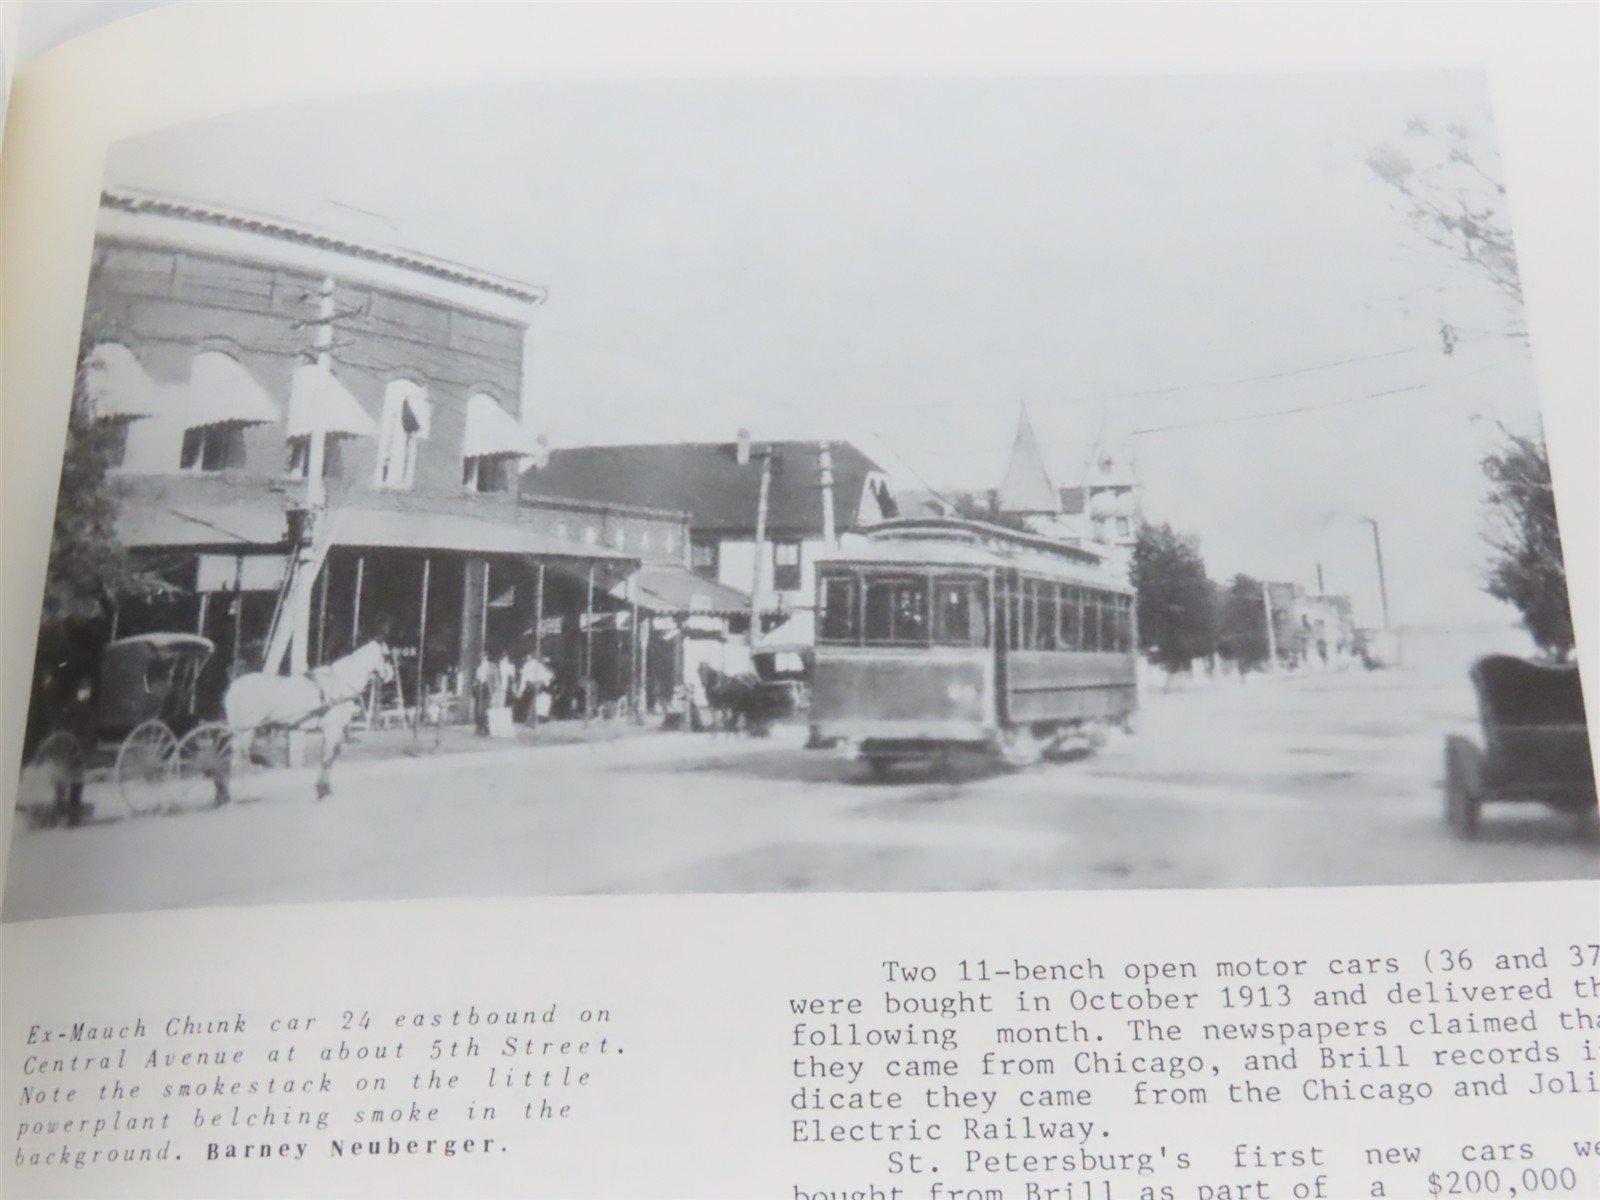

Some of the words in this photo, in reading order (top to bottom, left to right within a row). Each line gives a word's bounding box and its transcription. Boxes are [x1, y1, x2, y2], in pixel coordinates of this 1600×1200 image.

[882, 961, 936, 982] Two
[959, 958, 1104, 981] 11-bench
[1125, 960, 1197, 985] open
[1216, 958, 1307, 977] motor
[1329, 958, 1399, 975] cars
[1425, 949, 1472, 973] (36
[1496, 947, 1548, 970] and
[789, 999, 862, 1014] were
[885, 991, 992, 1018] bought
[1017, 991, 1051, 1011] in
[1070, 988, 1198, 1011] October
[1221, 984, 1291, 1008] 1913
[1314, 983, 1367, 1006] and
[1387, 977, 1552, 1004] delivered
[26, 1017, 146, 1045] Ex-Mauch
[165, 1012, 246, 1037] Chunk
[270, 1017, 317, 1032] car
[341, 1010, 371, 1031] 24
[394, 1003, 557, 1027] eastbound
[579, 1009, 610, 1023] on
[793, 1023, 957, 1051] following
[996, 1020, 1102, 1043] month.
[1127, 1019, 1181, 1041] The
[1203, 1020, 1387, 1045] newspapers
[1410, 1009, 1537, 1035] claimed
[1559, 1008, 1600, 1030] th
[23, 1048, 126, 1076] Central
[144, 1048, 244, 1069] Avenue
[267, 1045, 296, 1063] at
[320, 1040, 404, 1061] about
[429, 1036, 479, 1060] 5th
[501, 1036, 624, 1057] Street.
[793, 1056, 864, 1084] they
[886, 1060, 958, 1076] came
[982, 1052, 1054, 1075] from
[1074, 1051, 1219, 1078] Chicago,
[1245, 1047, 1298, 1070] and
[1320, 1045, 1409, 1068] Brill
[1432, 1040, 1560, 1065] records
[19, 1086, 77, 1106] Note
[99, 1079, 140, 1101] the
[162, 1072, 332, 1098] smokestack
[355, 1077, 386, 1091] on
[412, 1068, 459, 1090] the
[488, 1065, 590, 1088] little
[791, 1087, 901, 1110] dicate
[925, 1085, 997, 1114] they
[1020, 1090, 1091, 1107] came
[1134, 1081, 1207, 1104] from
[1228, 1080, 1281, 1103] the
[1303, 1078, 1432, 1105] Chicago
[1454, 1073, 1508, 1097] and
[16, 1110, 170, 1141] powerplant
[193, 1105, 330, 1131] belching
[354, 1101, 439, 1124] smoke
[468, 1100, 496, 1120] in
[524, 1097, 571, 1120] the
[792, 1119, 941, 1142] Electric
[964, 1116, 1109, 1144] Railway.
[15, 1139, 181, 1170] background.
[206, 1142, 308, 1161] Barney
[330, 1136, 507, 1158] Neuberger.
[889, 1151, 938, 1174] St.
[965, 1146, 1190, 1175] Petersburg's
[1234, 1144, 1324, 1167] first
[1365, 1147, 1420, 1164] new
[1462, 1144, 1533, 1161] cars
[930, 1182, 1003, 1200] from
[1025, 1180, 1110, 1200] Brill
[1140, 1186, 1174, 1200] as
[1293, 1175, 1327, 1199] of
[1370, 1181, 1386, 1197] a
[1429, 1167, 1576, 1199] $200,000
